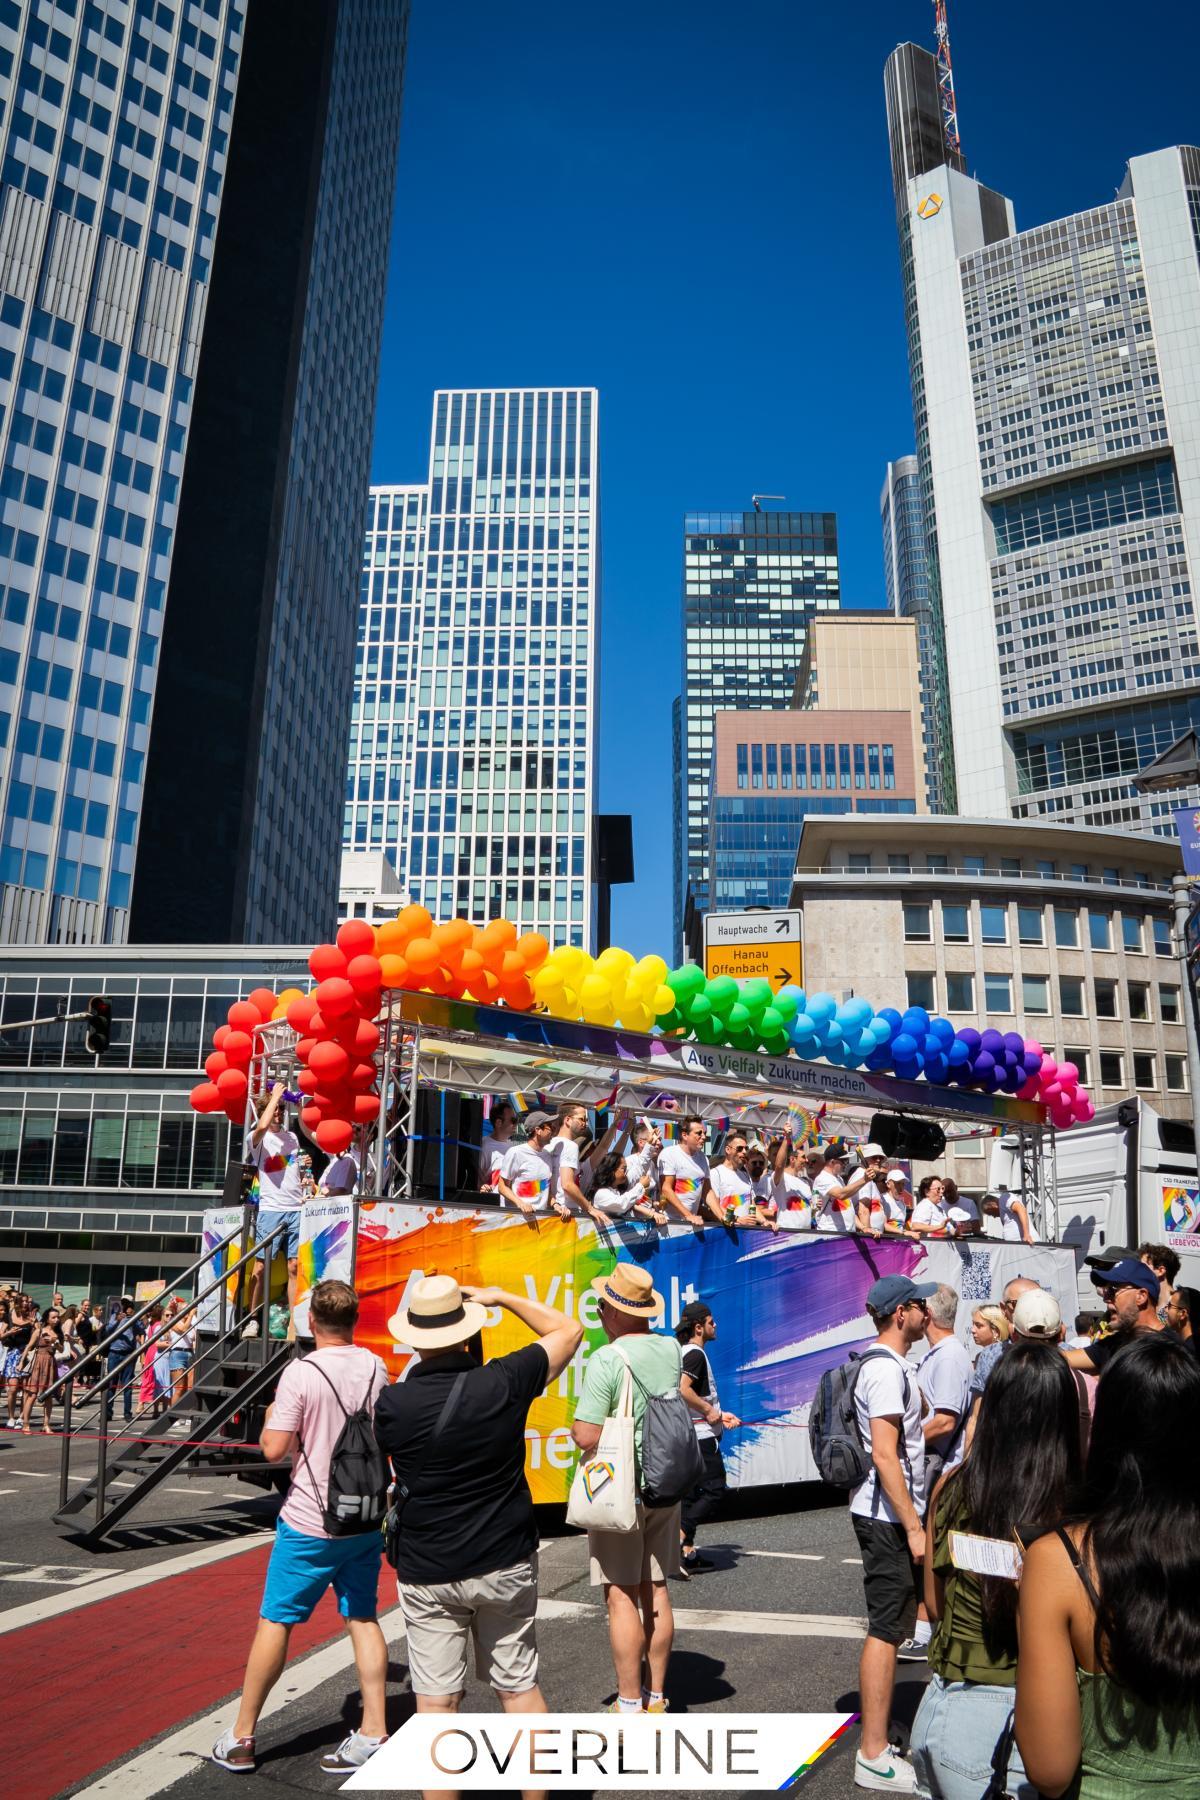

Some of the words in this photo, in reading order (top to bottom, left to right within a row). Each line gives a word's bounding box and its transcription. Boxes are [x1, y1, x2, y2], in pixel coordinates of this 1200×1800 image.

[718, 924, 768, 937] Hauptwache
[733, 950, 769, 960] Hanau
[712, 963, 769, 975] Offenbach
[687, 1050, 714, 1067] Aus
[718, 1054, 765, 1076] Vielfalt
[769, 1063, 817, 1084] Zukunft
[821, 1074, 866, 1092] machen
